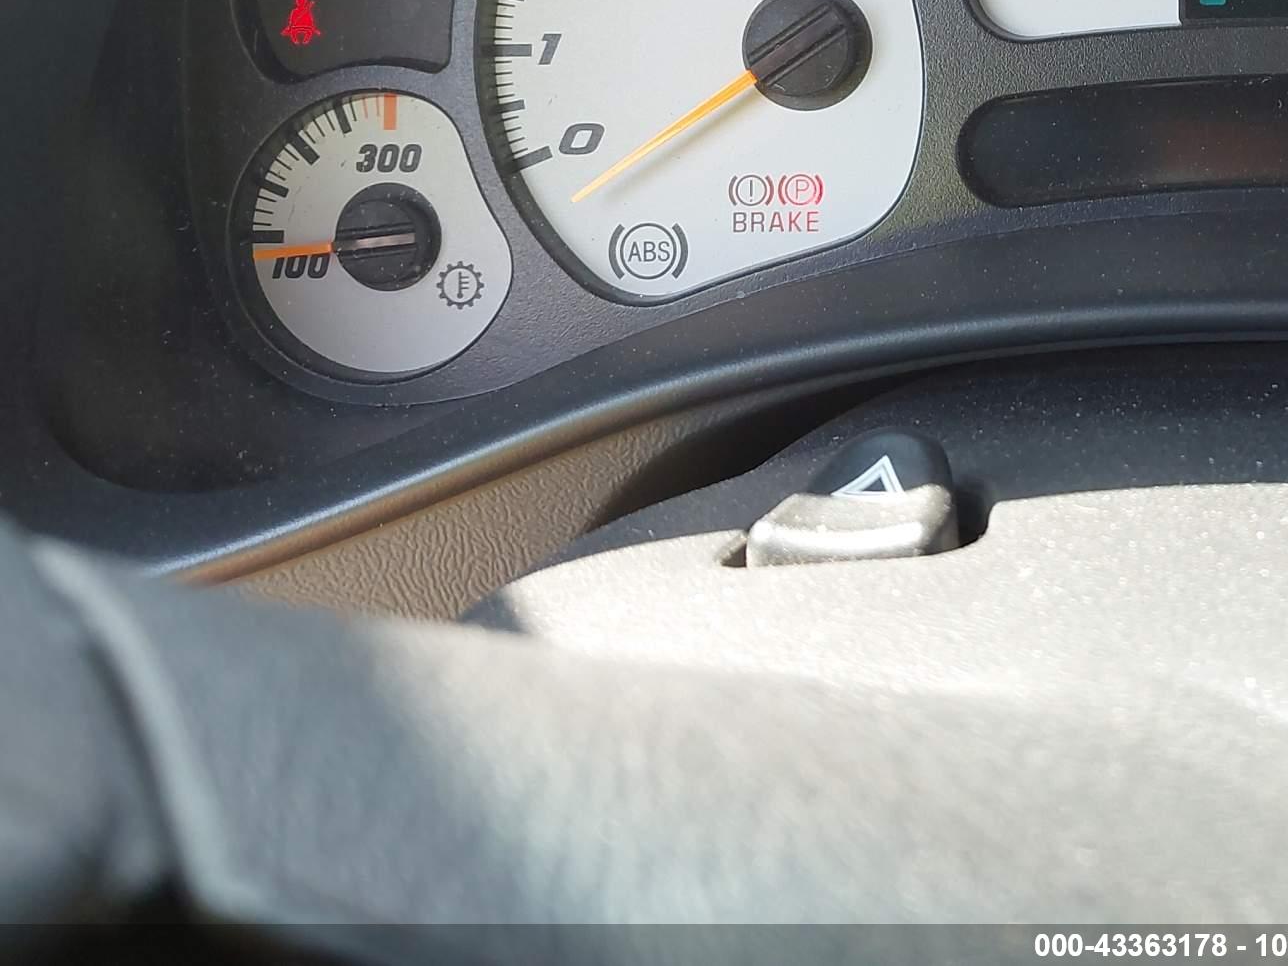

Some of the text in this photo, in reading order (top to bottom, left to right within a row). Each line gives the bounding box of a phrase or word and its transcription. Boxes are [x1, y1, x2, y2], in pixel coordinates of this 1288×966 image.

[539, 34, 561, 65] 1
[559, 123, 604, 155] 0
[356, 144, 421, 172] 300
[733, 212, 818, 232] BRAKE
[628, 241, 672, 262] ABS
[272, 253, 330, 279] 100
